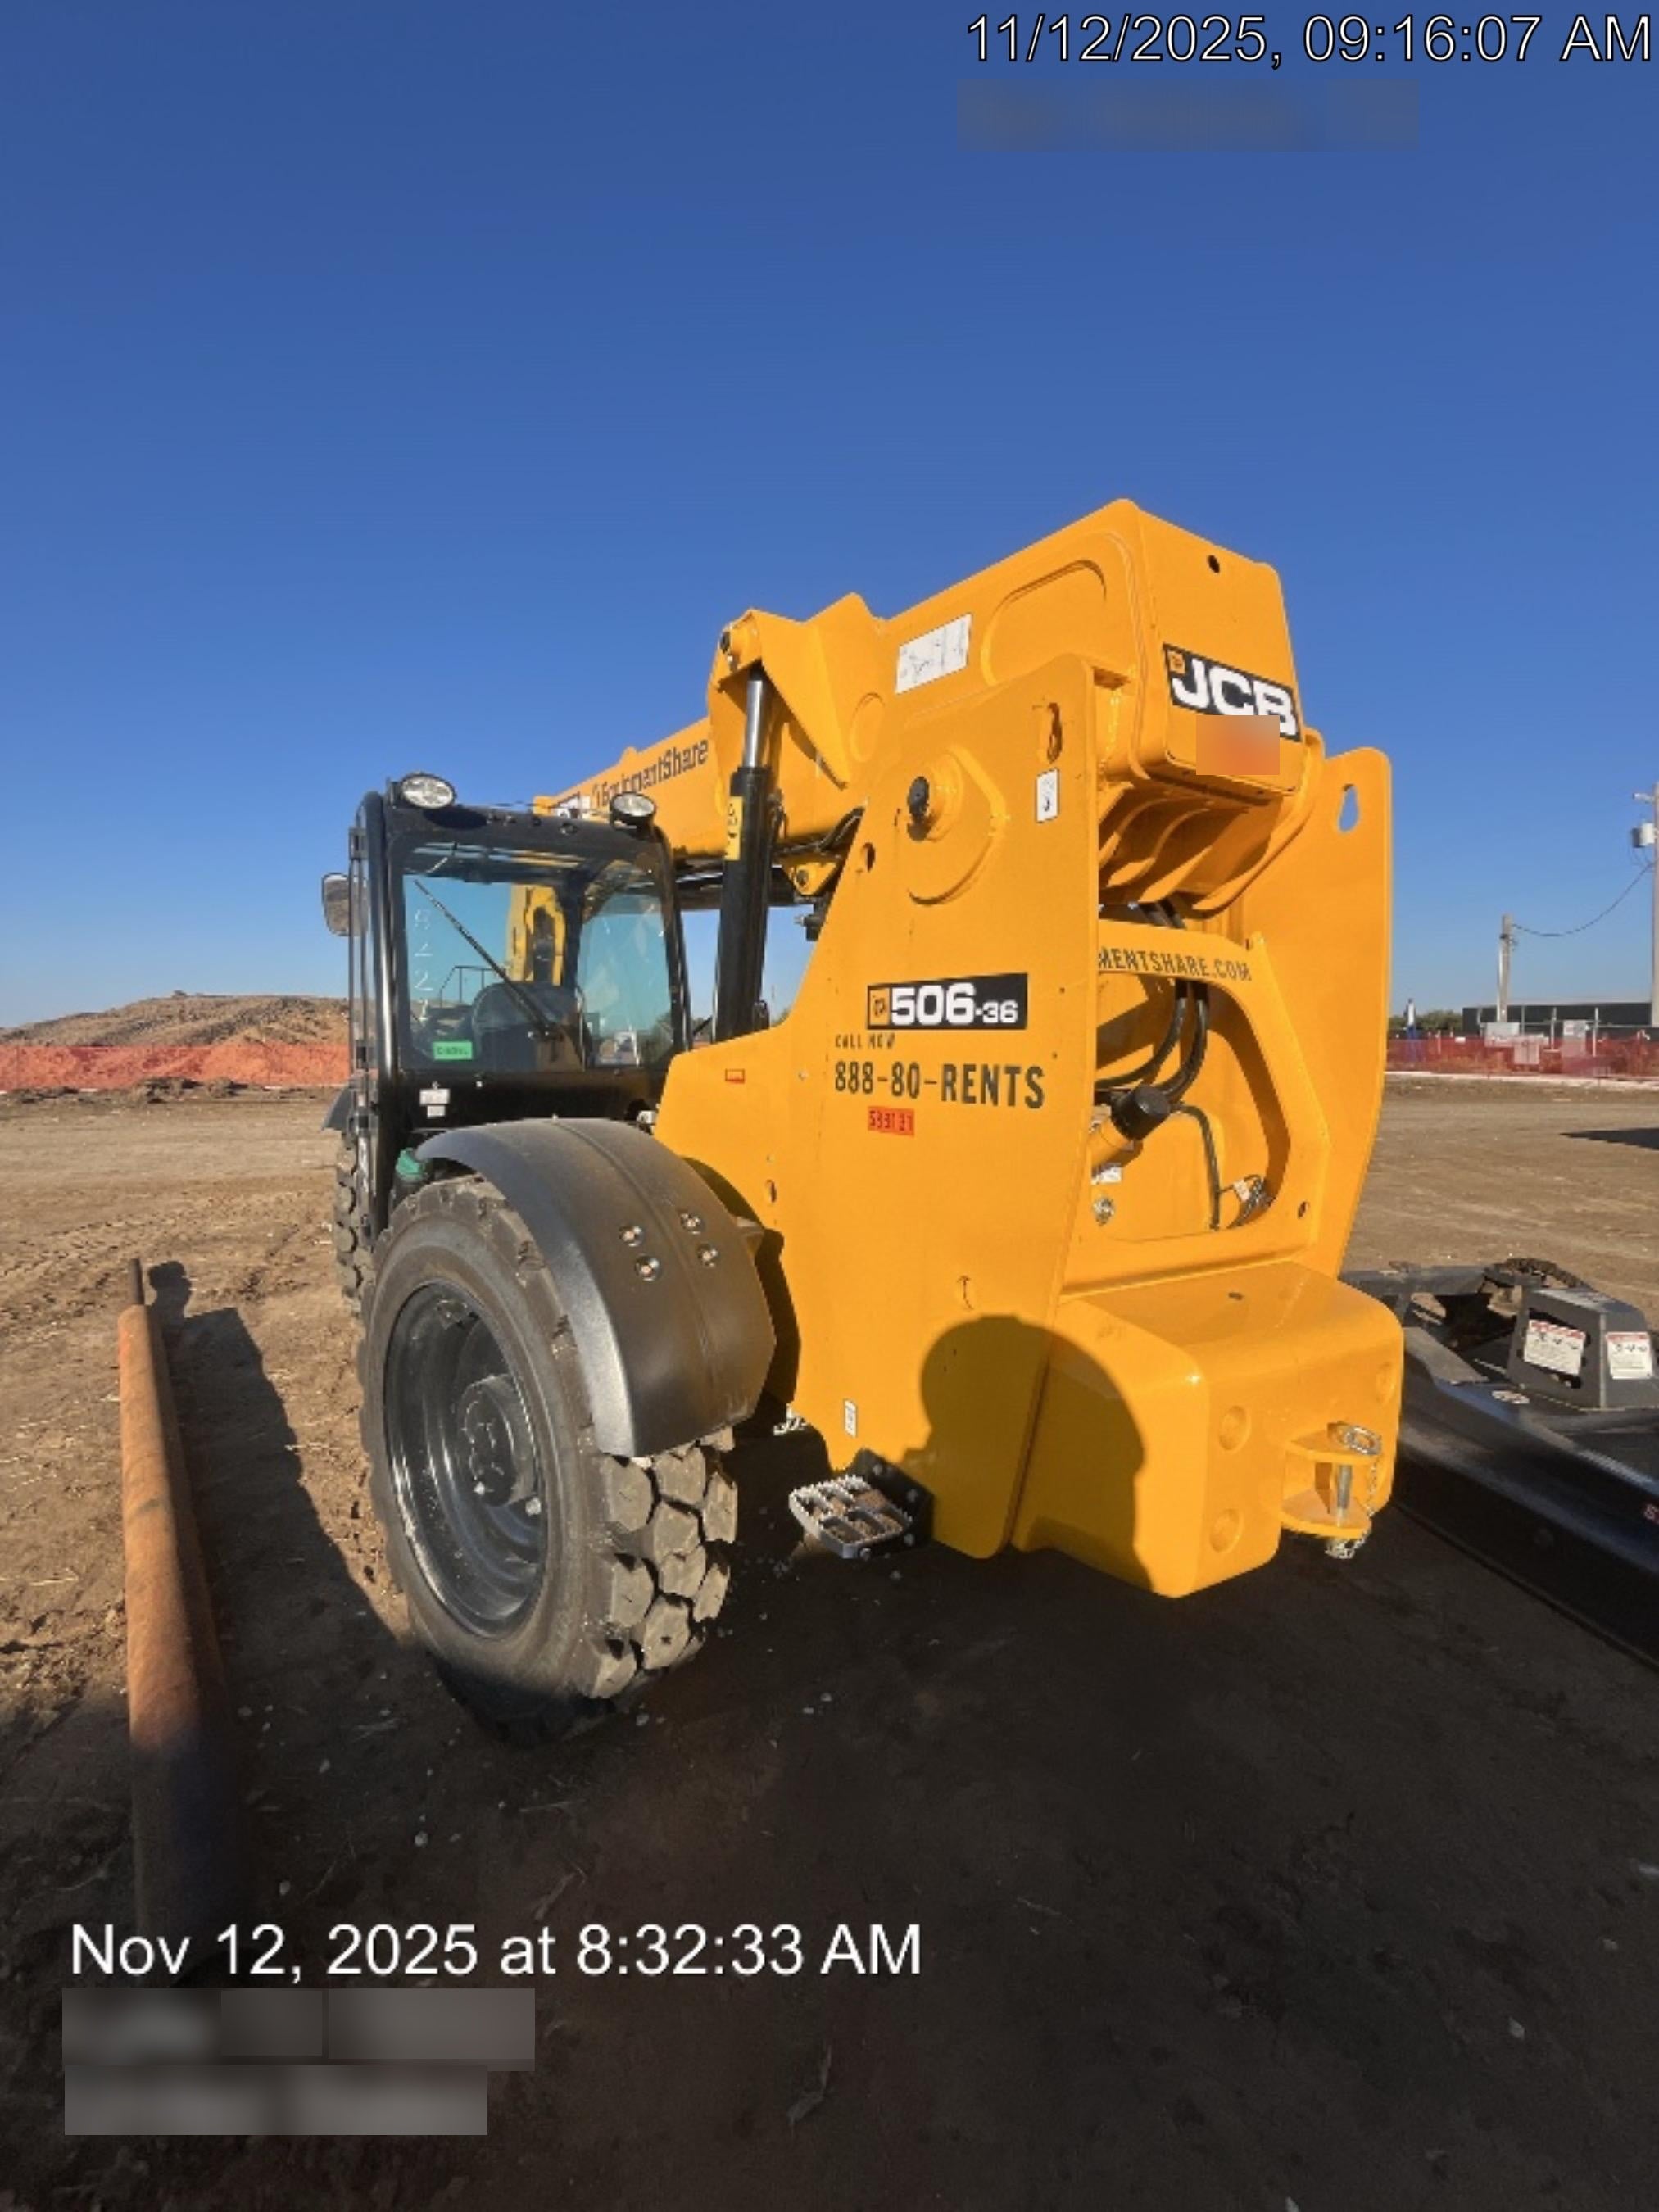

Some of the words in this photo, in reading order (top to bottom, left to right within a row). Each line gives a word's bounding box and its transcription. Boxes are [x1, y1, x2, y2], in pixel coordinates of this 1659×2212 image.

[1172, 658, 1298, 736] JCB
[890, 982, 1018, 1026] 506-36
[835, 1060, 1045, 1109] 888-80-RENTS
